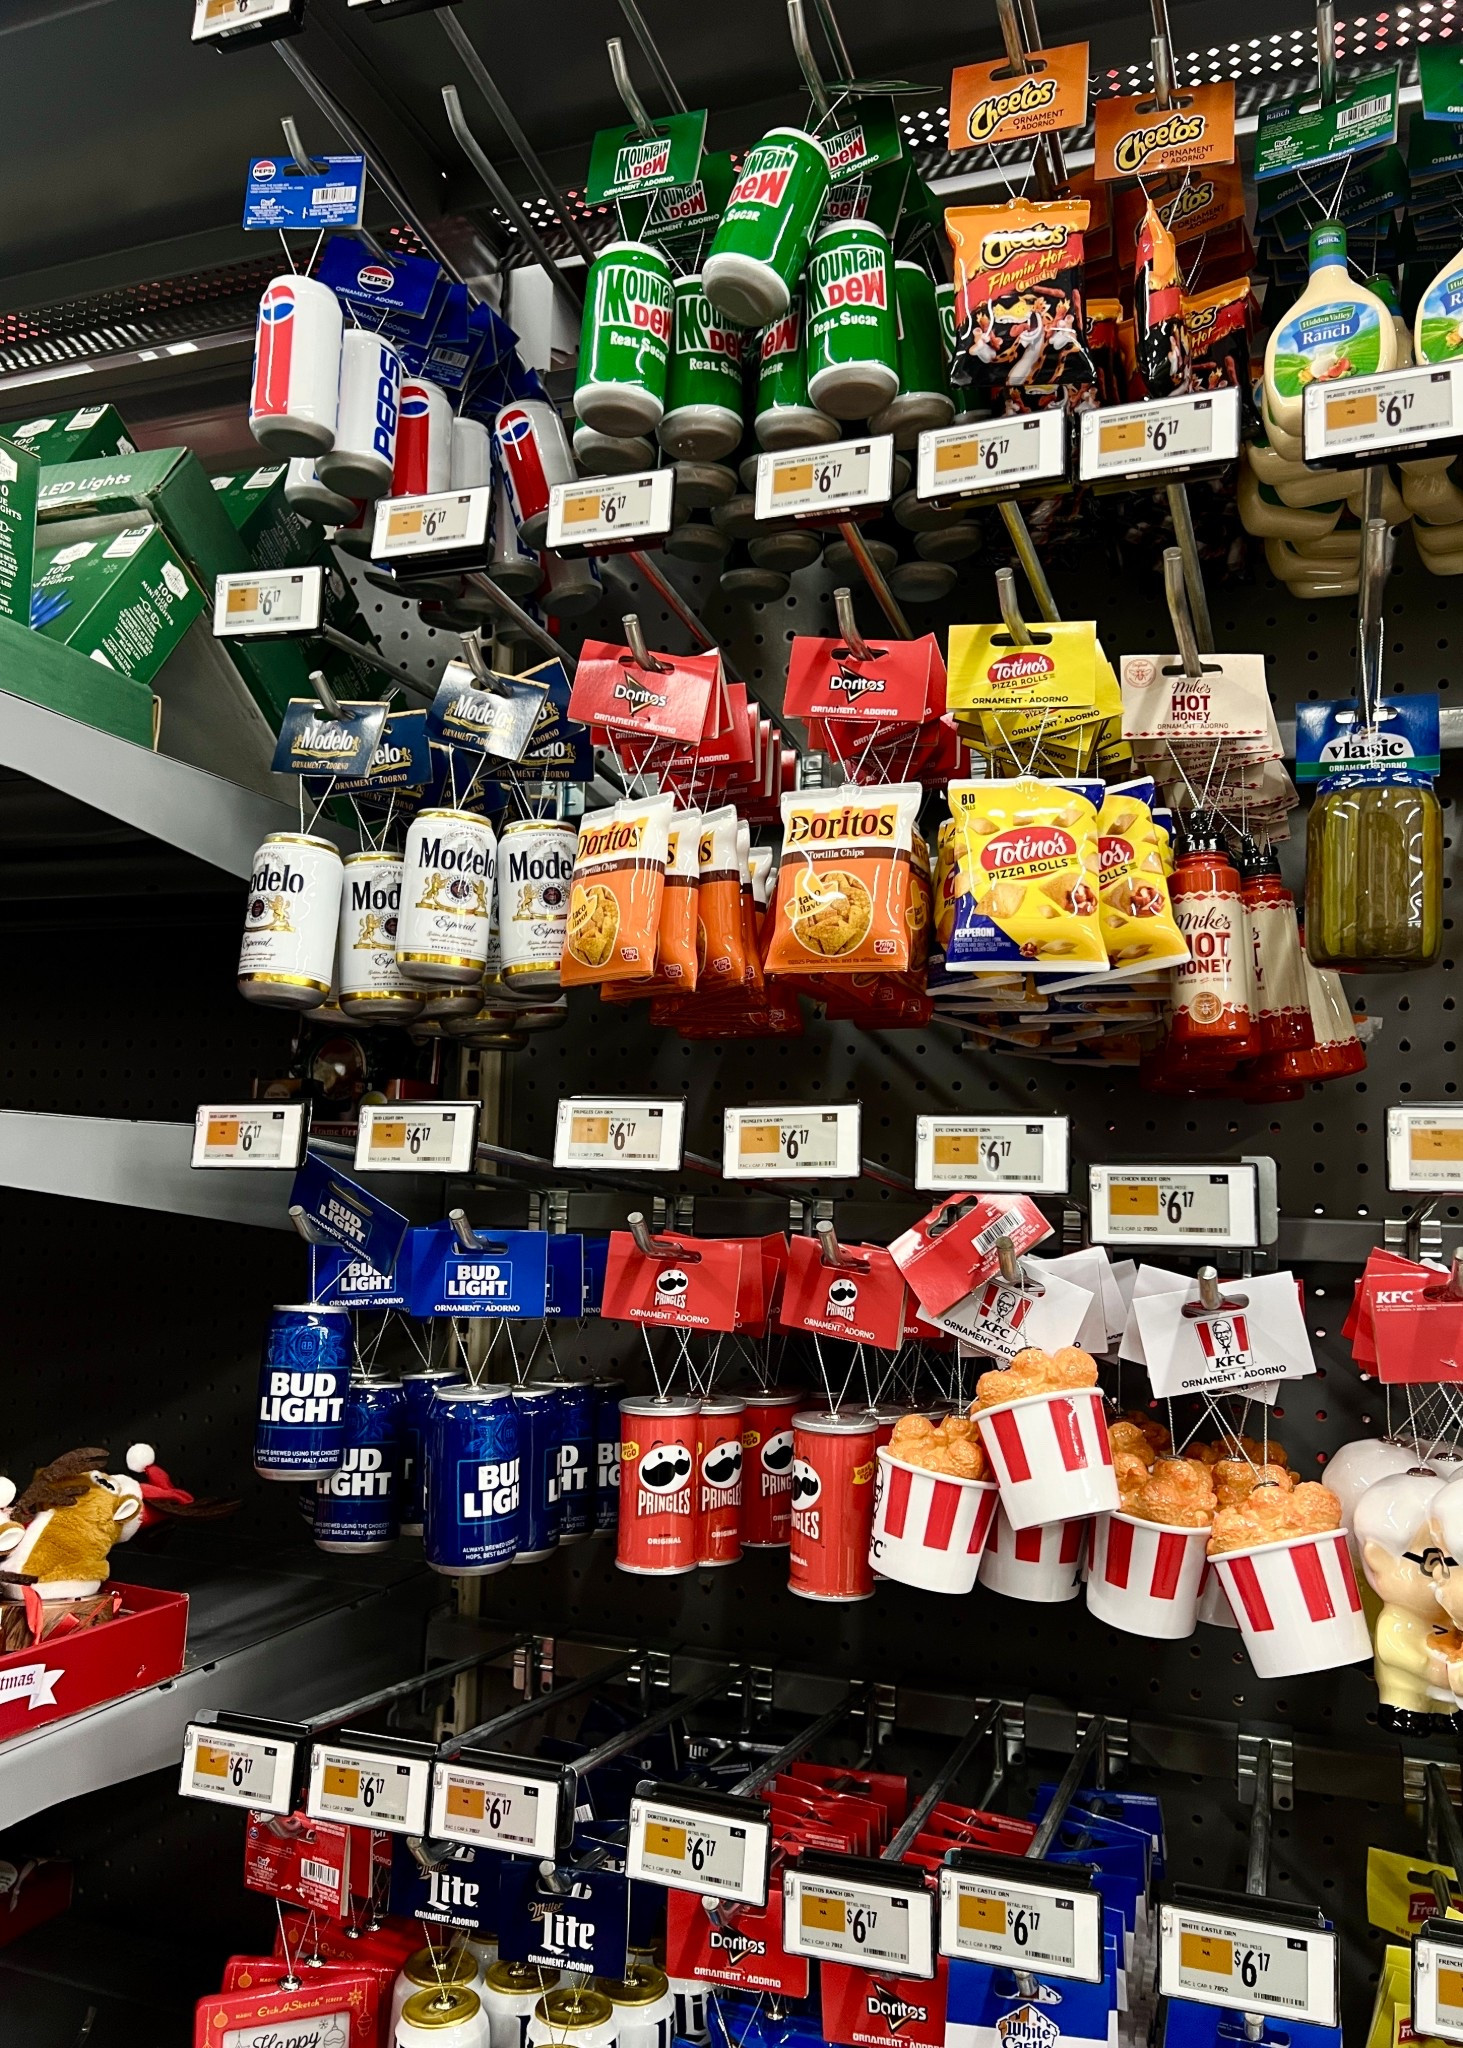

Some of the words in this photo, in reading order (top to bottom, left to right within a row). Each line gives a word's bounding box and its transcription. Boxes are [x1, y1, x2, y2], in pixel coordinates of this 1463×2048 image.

[969, 80, 1055, 141] Cheetos
[1013, 110, 1063, 126] ORNAMENT
[1266, 109, 1290, 121] Ranch
[1021, 118, 1055, 130] ADORNO
[1115, 116, 1205, 171] Cheetos
[1162, 145, 1214, 159] ORNAMENT
[846, 155, 879, 173] ADORNO
[1170, 153, 1205, 164] ADORNO
[603, 182, 639, 196] ORNAMENT
[644, 176, 674, 186] ADORNO
[688, 214, 719, 226] ADORNO
[1178, 204, 1224, 230] ORNAMENT
[982, 225, 1067, 266] Cheetos
[1317, 235, 1340, 245] Ranch
[989, 261, 1037, 290] Flamin'
[1039, 249, 1067, 269] Hot
[360, 273, 392, 285] PEPSI
[336, 286, 371, 300] ORNAMENT
[376, 296, 403, 306] ADORNO
[1303, 315, 1329, 329] Hidden
[1329, 312, 1352, 323] Valley
[1303, 324, 1350, 345] Ranch
[39, 481, 75, 497] LED
[79, 474, 131, 491] Lights
[47, 564, 71, 573] 100
[158, 582, 173, 604] 100
[993, 656, 1049, 680] Totino's
[830, 676, 885, 691] Doritos
[992, 680, 1017, 690] PIZZA
[1020, 674, 1048, 686] ROLLS
[1172, 681, 1211, 694] Mike's
[615, 684, 668, 708] Doritos
[1172, 695, 1210, 711] HOT
[454, 695, 510, 727] Modelo
[811, 706, 857, 714] ORNAMENT
[1172, 712, 1210, 721] HONEY
[594, 713, 639, 727] ORNAMENT
[643, 722, 676, 734] ADORNO
[1012, 721, 1059, 735] ORNAMENT
[1064, 710, 1100, 723] ADORNO
[301, 727, 353, 750] Modelo
[532, 729, 559, 746] ADORNO
[1328, 739, 1403, 759] vlasic
[292, 761, 322, 769] ORNAMENT
[335, 779, 373, 790] ORNAMENT
[379, 774, 407, 784] ADORNO
[961, 793, 975, 805] 80
[789, 810, 894, 842] Doritos
[577, 825, 643, 859] Doritos
[987, 833, 1067, 866] Totino's
[418, 837, 495, 880] Modelo
[807, 850, 839, 859] Tortilla
[841, 849, 864, 858] Chips
[601, 862, 618, 871] Chips
[989, 865, 1025, 881] PIZZA
[1031, 859, 1068, 873] ROLLS
[572, 904, 587, 918] taco
[1177, 907, 1231, 930] Mike's
[433, 915, 477, 932] Especial
[955, 927, 995, 938] PEPPERONI
[1177, 959, 1231, 976] HONEY
[329, 1199, 362, 1228] BUD
[320, 1204, 366, 1243] LIGHT
[307, 1213, 342, 1241] ORNAMENT
[344, 1240, 371, 1262] ADORNO
[457, 1265, 500, 1280] BUD
[341, 1276, 392, 1291] LIGHT
[448, 1281, 508, 1296] LIGHT
[655, 1291, 686, 1308] PRINGLES
[1376, 1291, 1413, 1304] KFC
[434, 1304, 481, 1312] ORNAMENT
[630, 1309, 671, 1320] ORNAMENT
[676, 1314, 709, 1324] ADORNO
[826, 1301, 855, 1322] PRINGLES
[804, 1318, 841, 1332] ORNAMENT
[845, 1327, 875, 1340] ADORNO
[981, 1319, 1010, 1339] KFC
[1215, 1354, 1246, 1368] KFC
[270, 1372, 336, 1397] BUD
[1182, 1373, 1236, 1388] ORNAMENT
[1244, 1364, 1287, 1378] ADORNO
[260, 1398, 344, 1423] LIGHT
[638, 1488, 690, 1517] PRINGLES
[648, 1536, 681, 1545] ORIGINAL
[689, 1744, 709, 1758] Lite
[647, 1813, 668, 1822] DORITOS
[427, 1870, 478, 1910] Lite
[802, 1885, 824, 1894] DORITOS
[825, 1888, 843, 1896] RANCH
[959, 1885, 976, 1893] WHITE
[977, 1887, 997, 1896] CASTLE
[528, 1901, 564, 1922] Miller
[540, 1912, 594, 1954] Lite
[1181, 1922, 1199, 1931] WHITE
[1201, 1925, 1222, 1935] CASTLE
[711, 1932, 765, 1954] Doritos
[528, 1955, 563, 1968] ORNAMENT
[566, 1961, 594, 1973] ADORNO
[694, 1967, 741, 1981] ORNAMENT
[747, 1974, 781, 1988] ADORNO
[868, 1998, 927, 2020] Doritos
[253, 2030, 322, 2048] Happy
[1006, 2020, 1051, 2040] White
[853, 2033, 902, 2047] ORNAMENT
